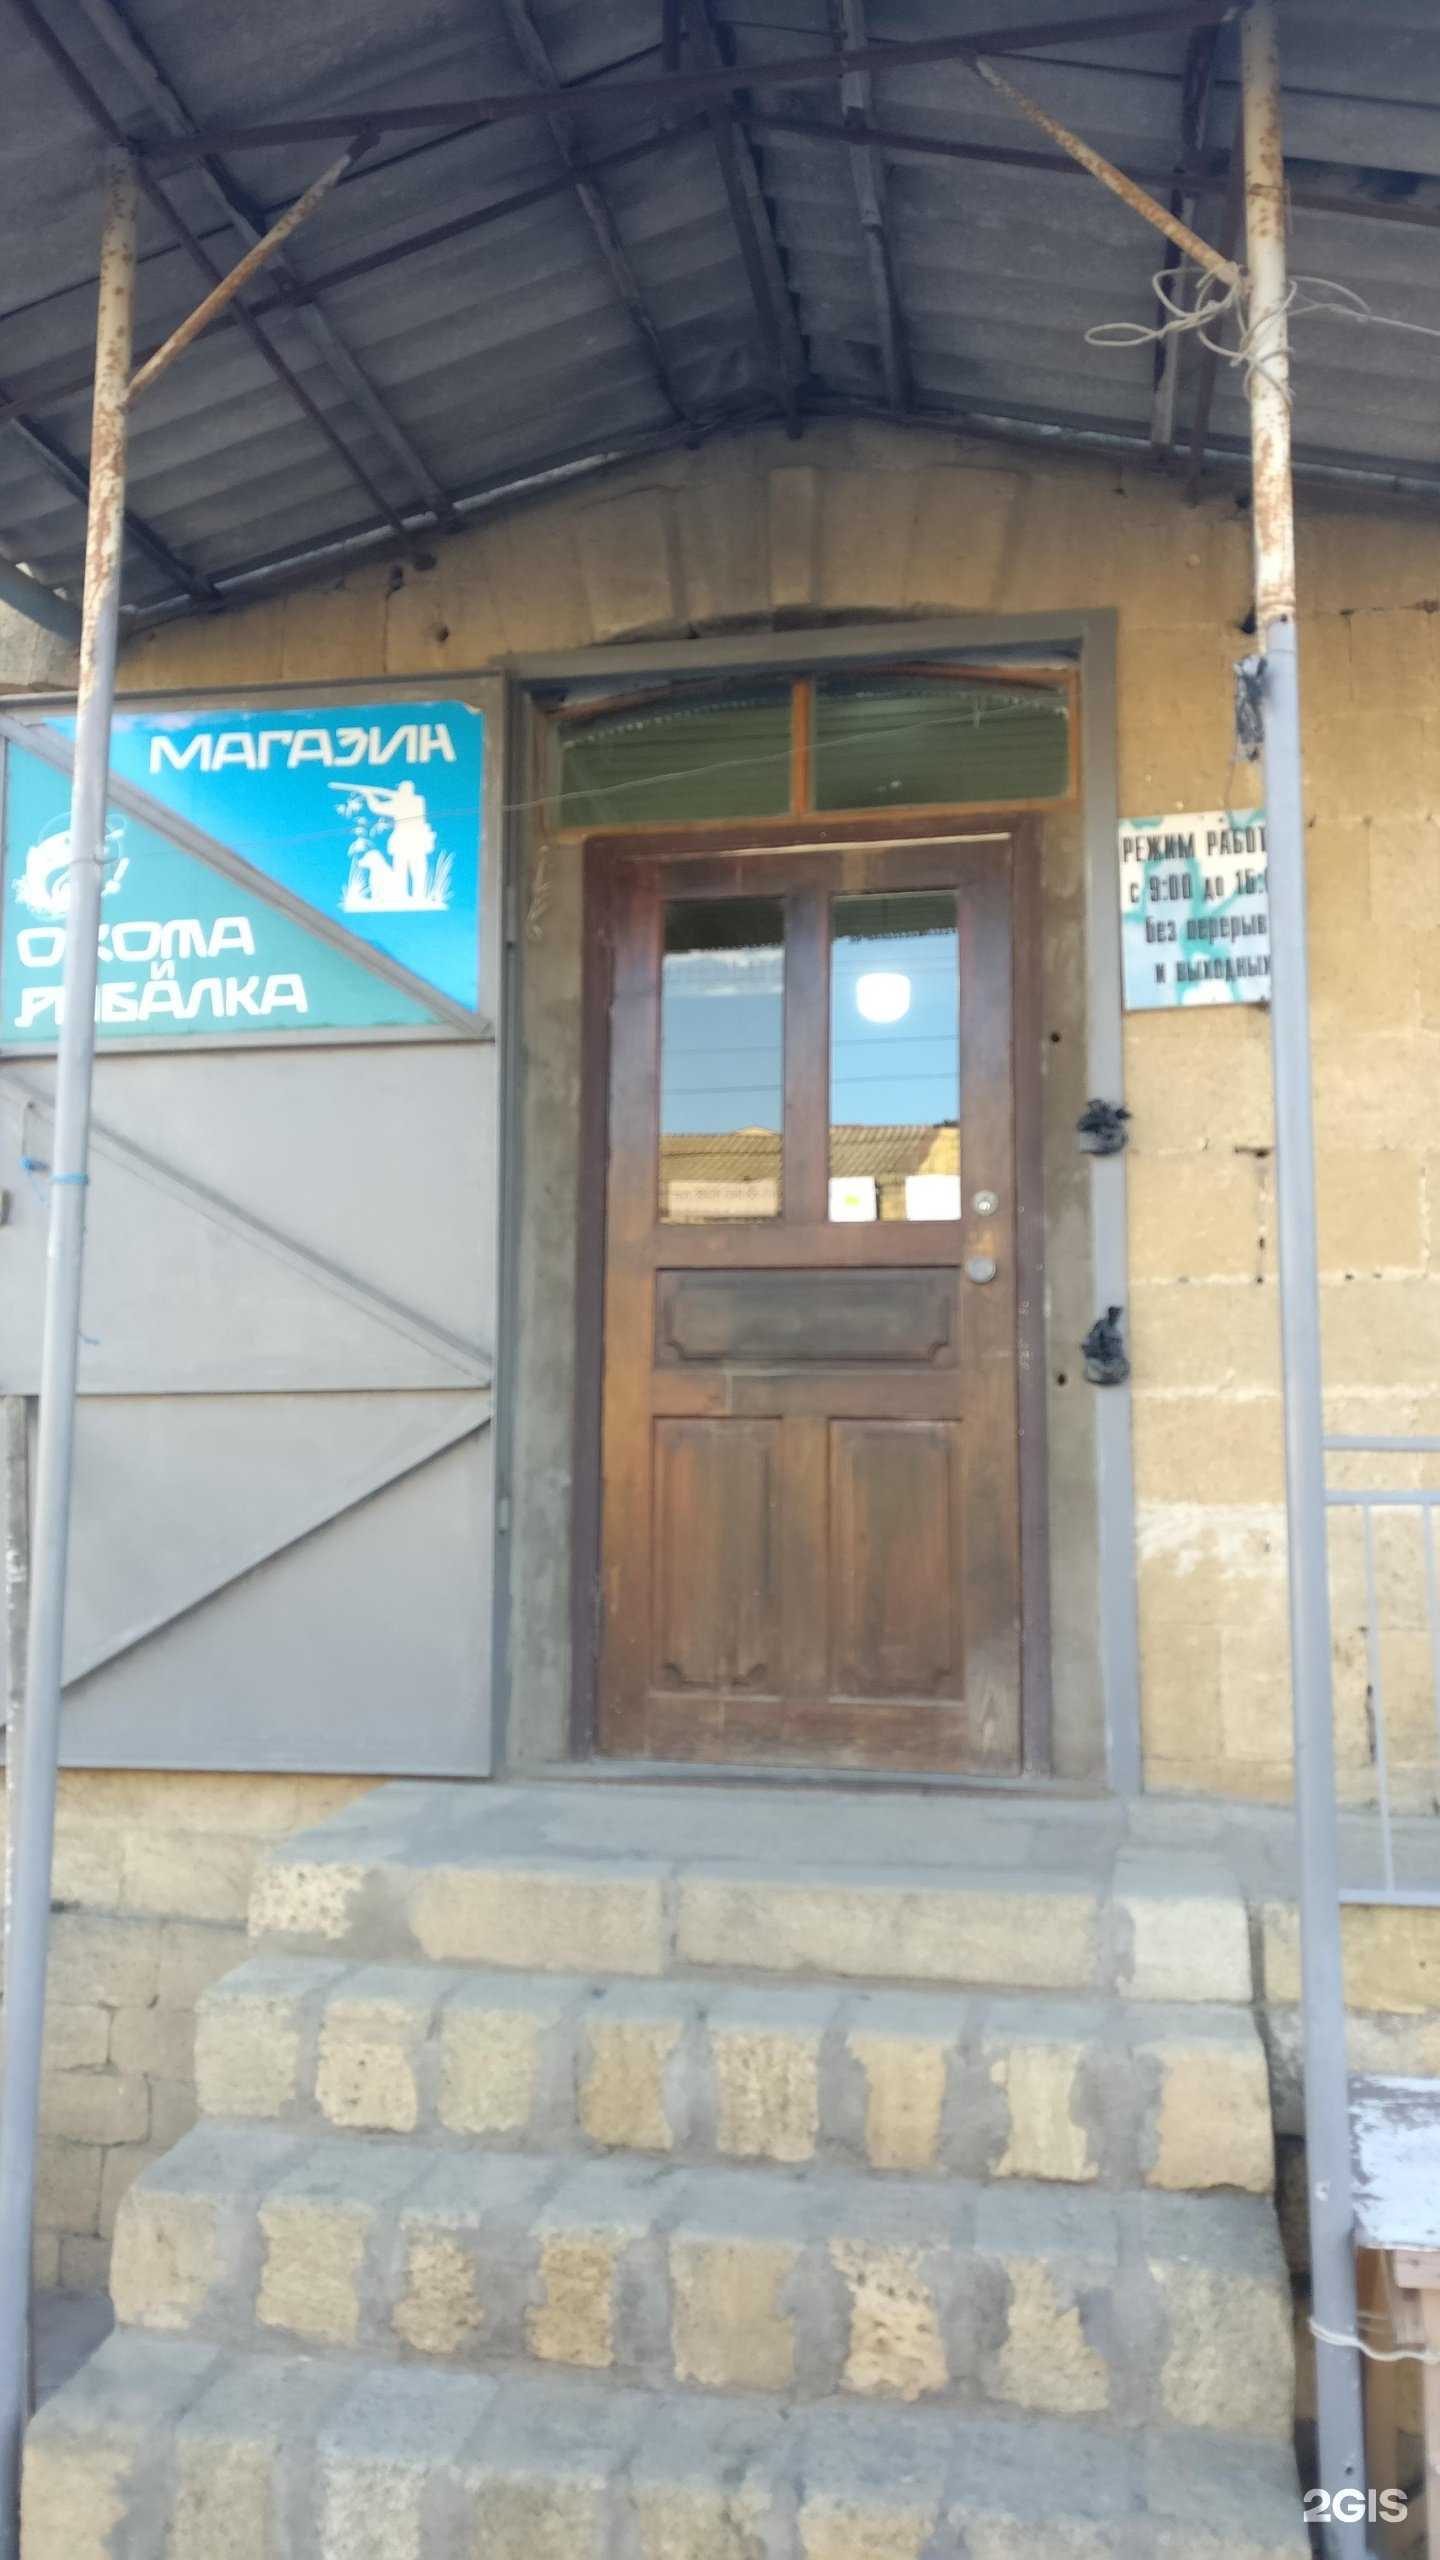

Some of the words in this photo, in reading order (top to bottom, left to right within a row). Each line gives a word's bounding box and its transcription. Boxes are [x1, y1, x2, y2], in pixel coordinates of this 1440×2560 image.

[149, 723, 457, 774] МАГАЗИН
[1122, 831, 1195, 863] РЕЖИМ
[1206, 826, 1267, 857] РАБОТ
[1149, 873, 1193, 902] 9:00
[1145, 915, 1176, 944] без
[1186, 912, 1267, 945] перерыв
